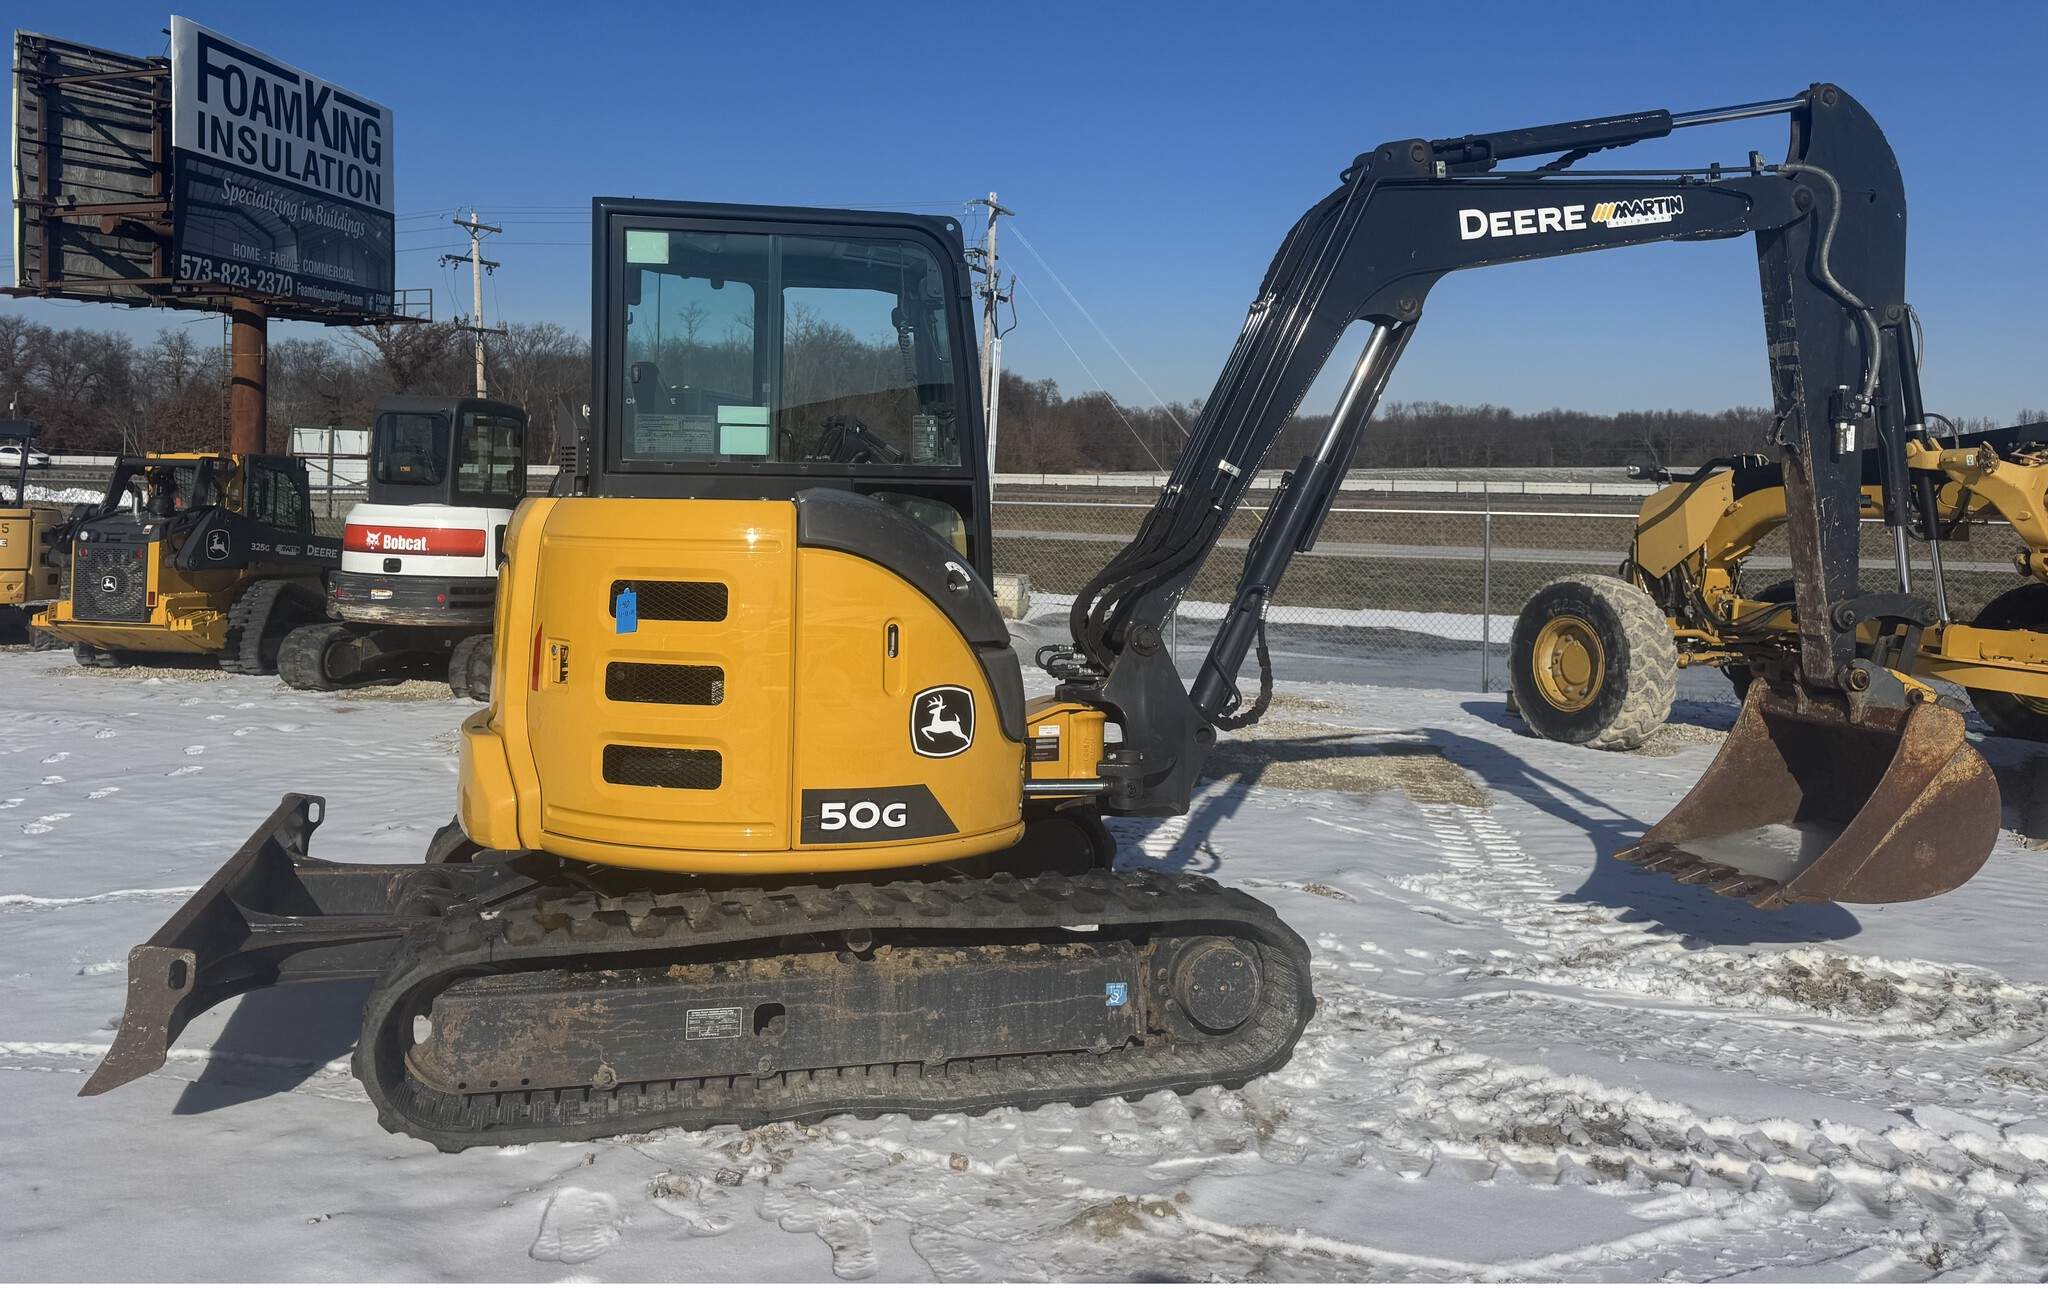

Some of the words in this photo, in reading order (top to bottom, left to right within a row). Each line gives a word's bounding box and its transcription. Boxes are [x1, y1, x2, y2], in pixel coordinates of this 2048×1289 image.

[198, 110, 381, 205] INSULATION
[221, 178, 298, 222] Specializing
[301, 201, 313, 222] in
[315, 205, 365, 239] Buildings
[1459, 205, 1587, 240] DEERE
[1612, 195, 1683, 219] MARTIN
[180, 254, 293, 297] 573-823-2370
[233, 243, 261, 262] HOME
[269, 251, 294, 270] FARM
[302, 259, 355, 282] COMMERCIAL
[250, 542, 270, 552] 325G
[306, 544, 338, 558] DEERE
[821, 802, 907, 830] 50G
